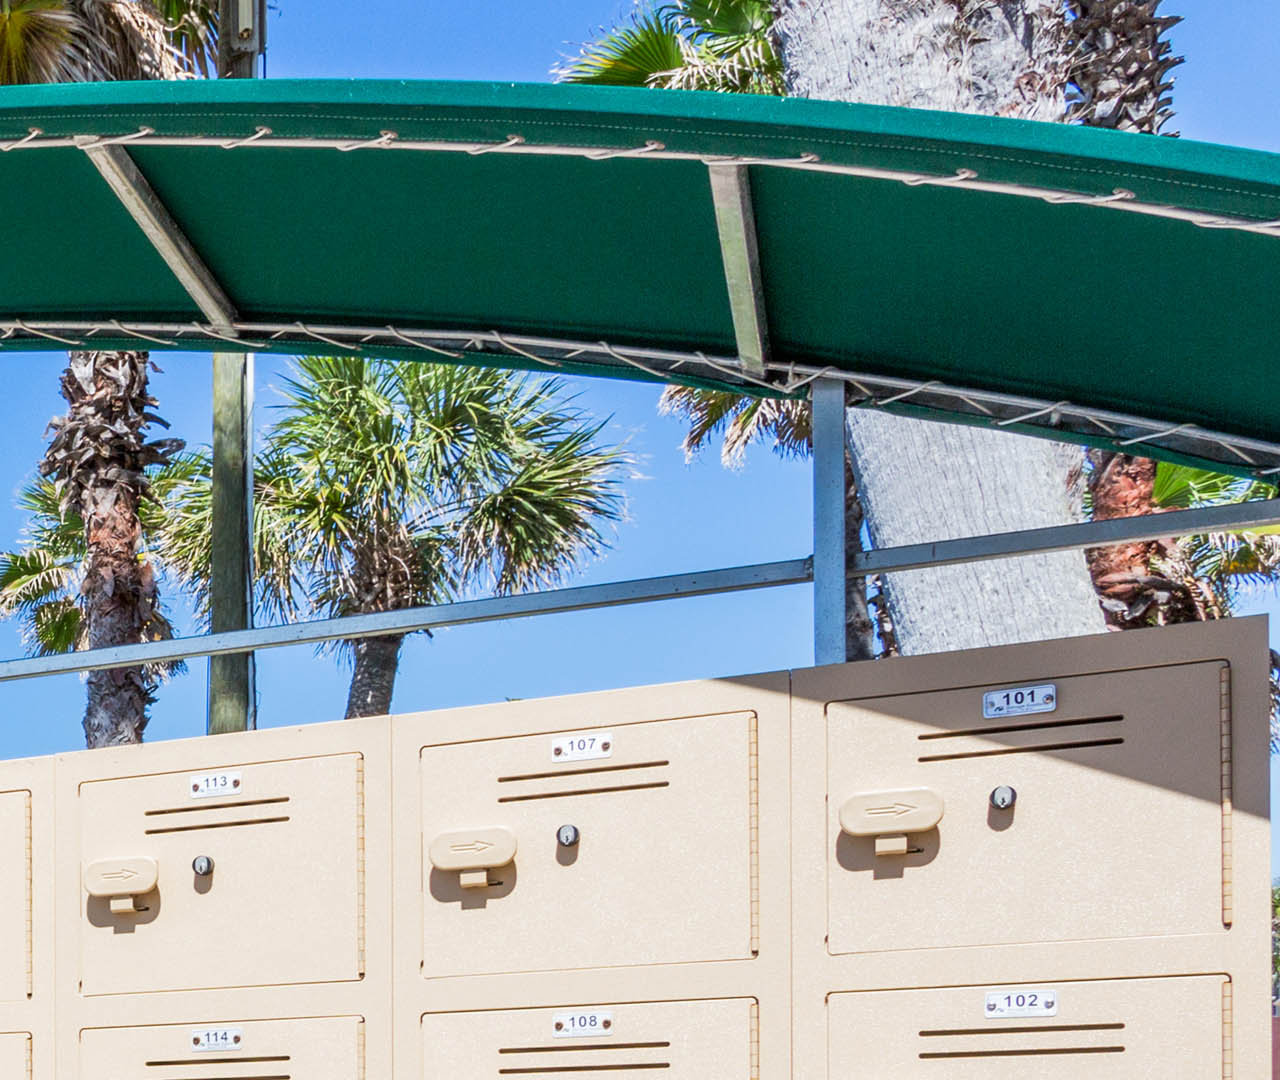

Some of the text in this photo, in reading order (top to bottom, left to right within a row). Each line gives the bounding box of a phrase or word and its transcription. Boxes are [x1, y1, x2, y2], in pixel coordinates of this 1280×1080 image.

[1003, 690, 1036, 706] 101
[569, 738, 596, 751] 107
[204, 776, 228, 788] 113
[1004, 994, 1038, 1008] 102
[569, 1015, 597, 1028] 108
[205, 1031, 228, 1042] 114
